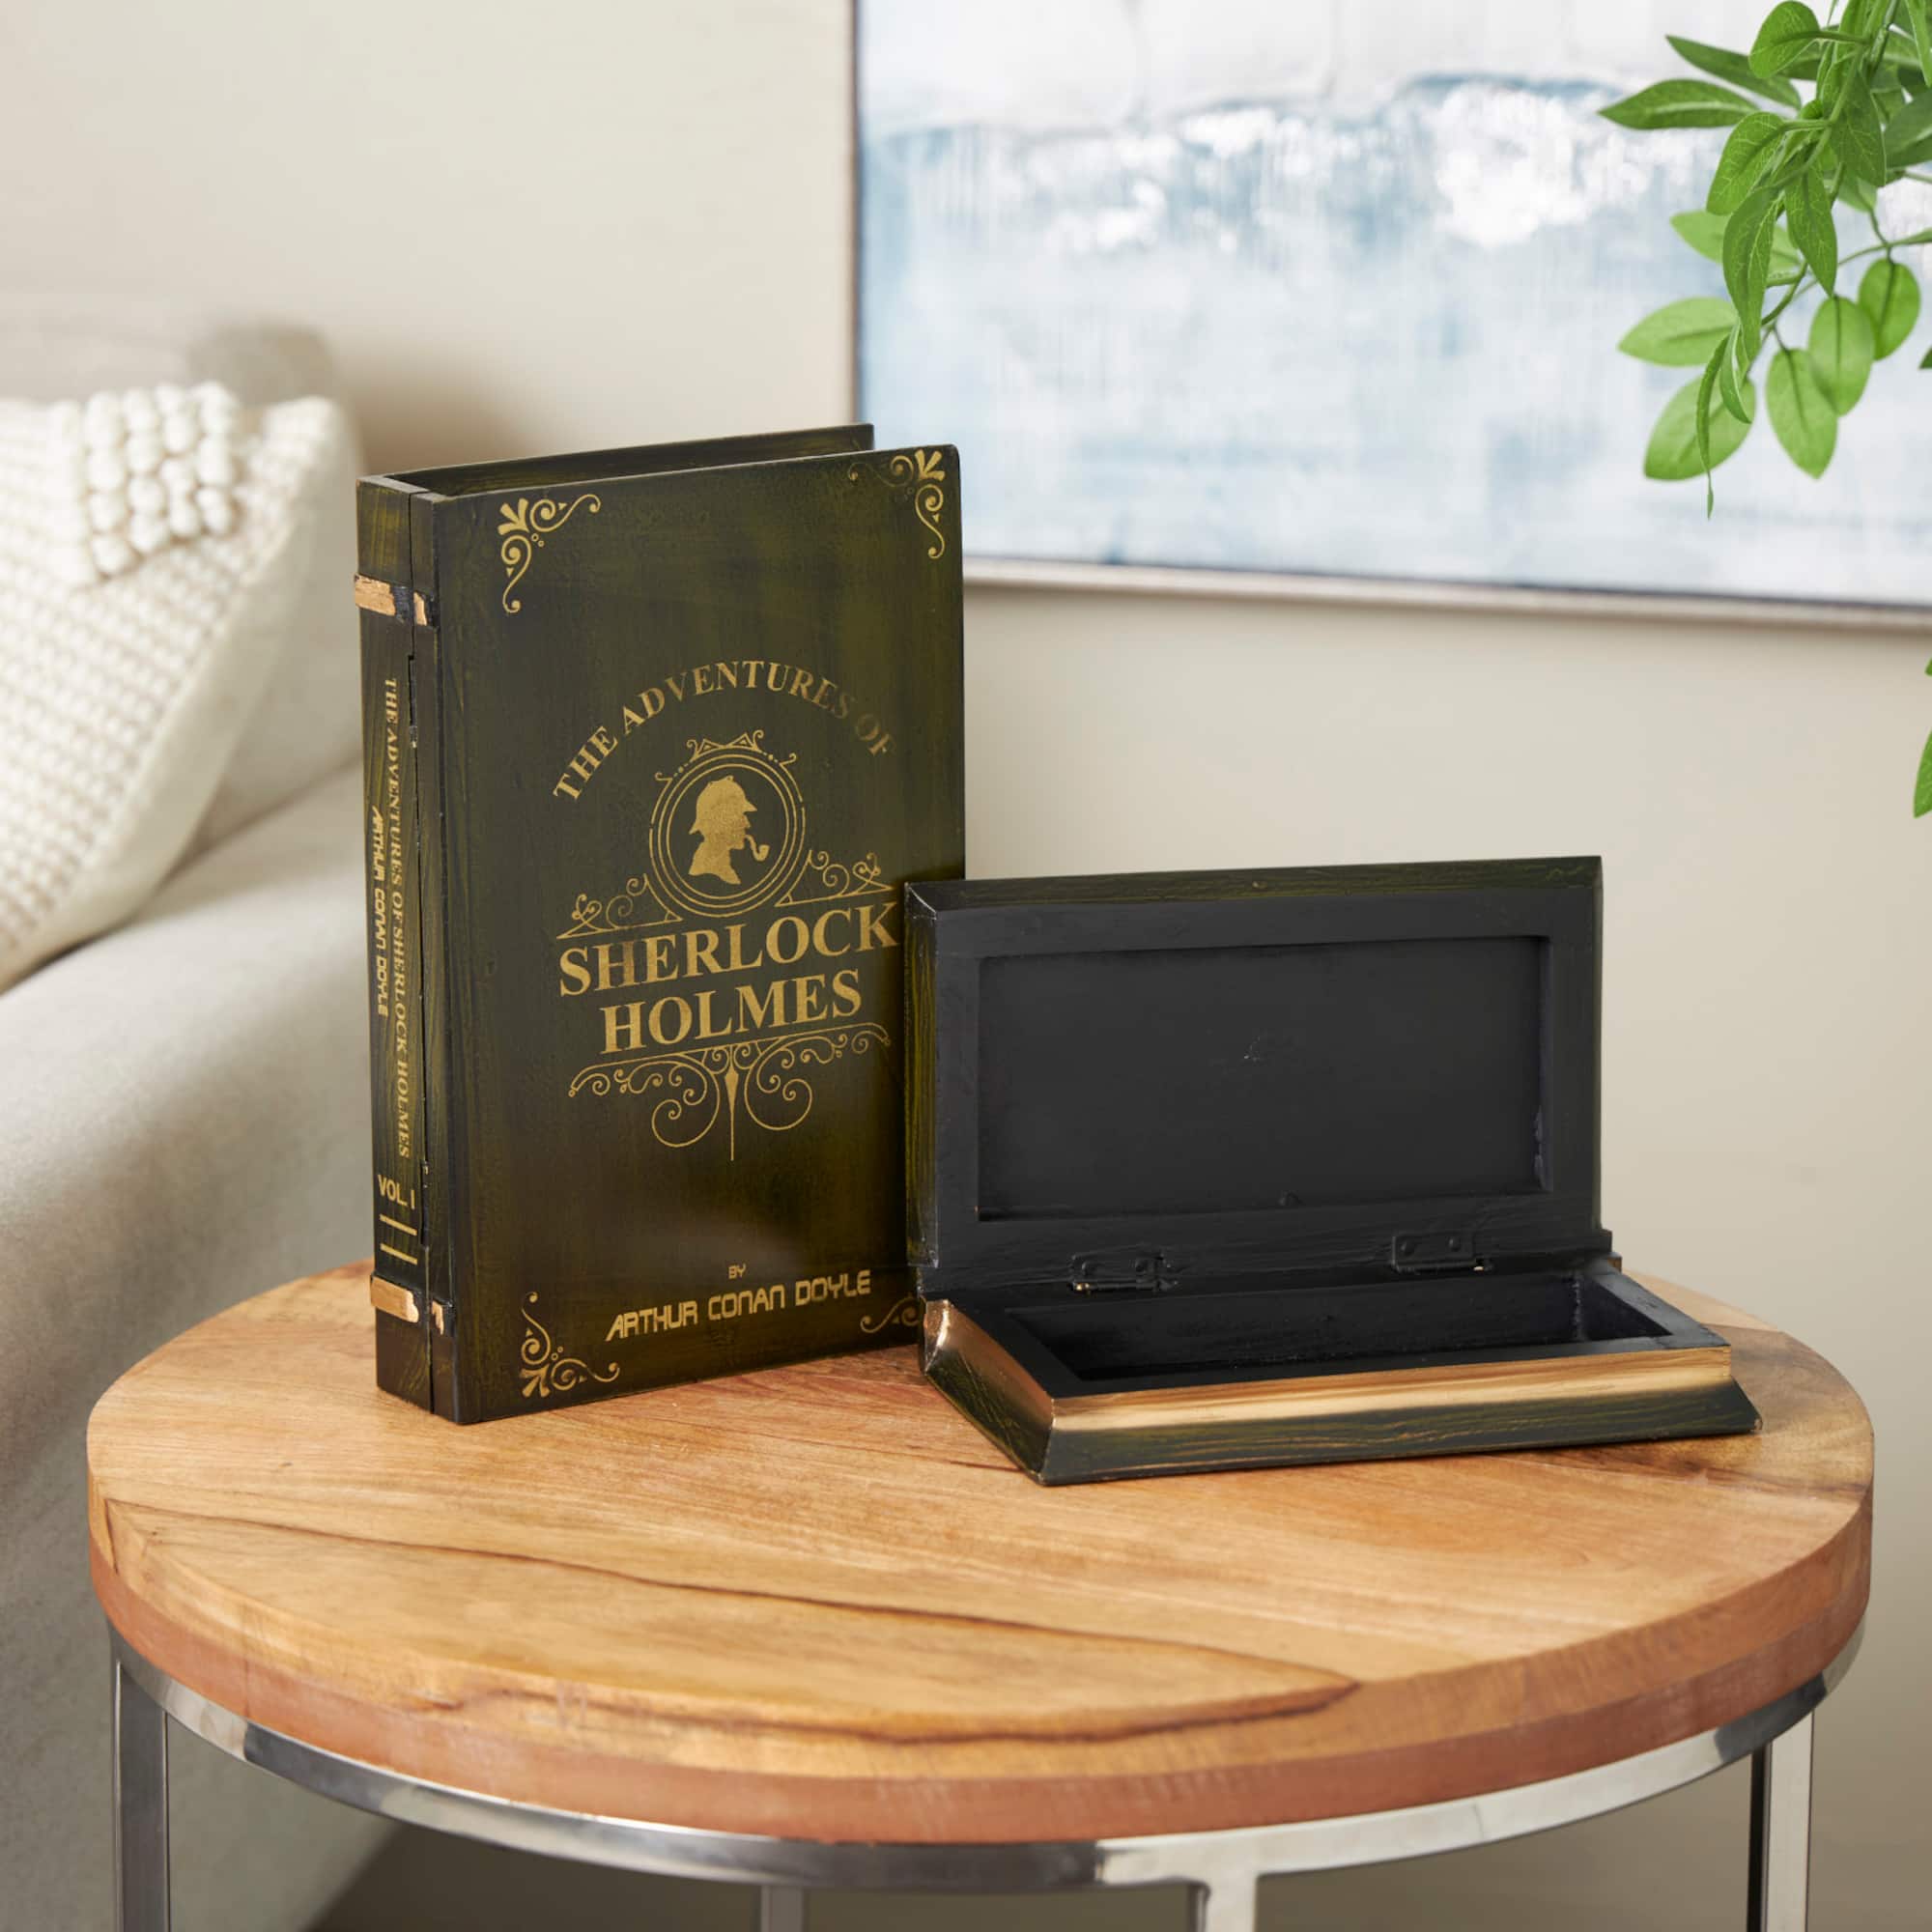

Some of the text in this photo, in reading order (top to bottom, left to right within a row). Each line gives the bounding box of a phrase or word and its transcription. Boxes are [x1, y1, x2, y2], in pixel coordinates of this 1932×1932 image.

[553, 660, 896, 802] THE ADVENTURES OF
[371, 805, 388, 1018] ARTHUR CONAN DOYLE
[384, 678, 411, 1158] THE ADVENTURES OF SHERLOCK HOLMES
[558, 900, 900, 998] SHERLOCK
[599, 968, 863, 1055] HOLMES
[605, 1269, 871, 1342] ARTHUR CONAN DOYLE
[728, 1264, 746, 1279] BY
